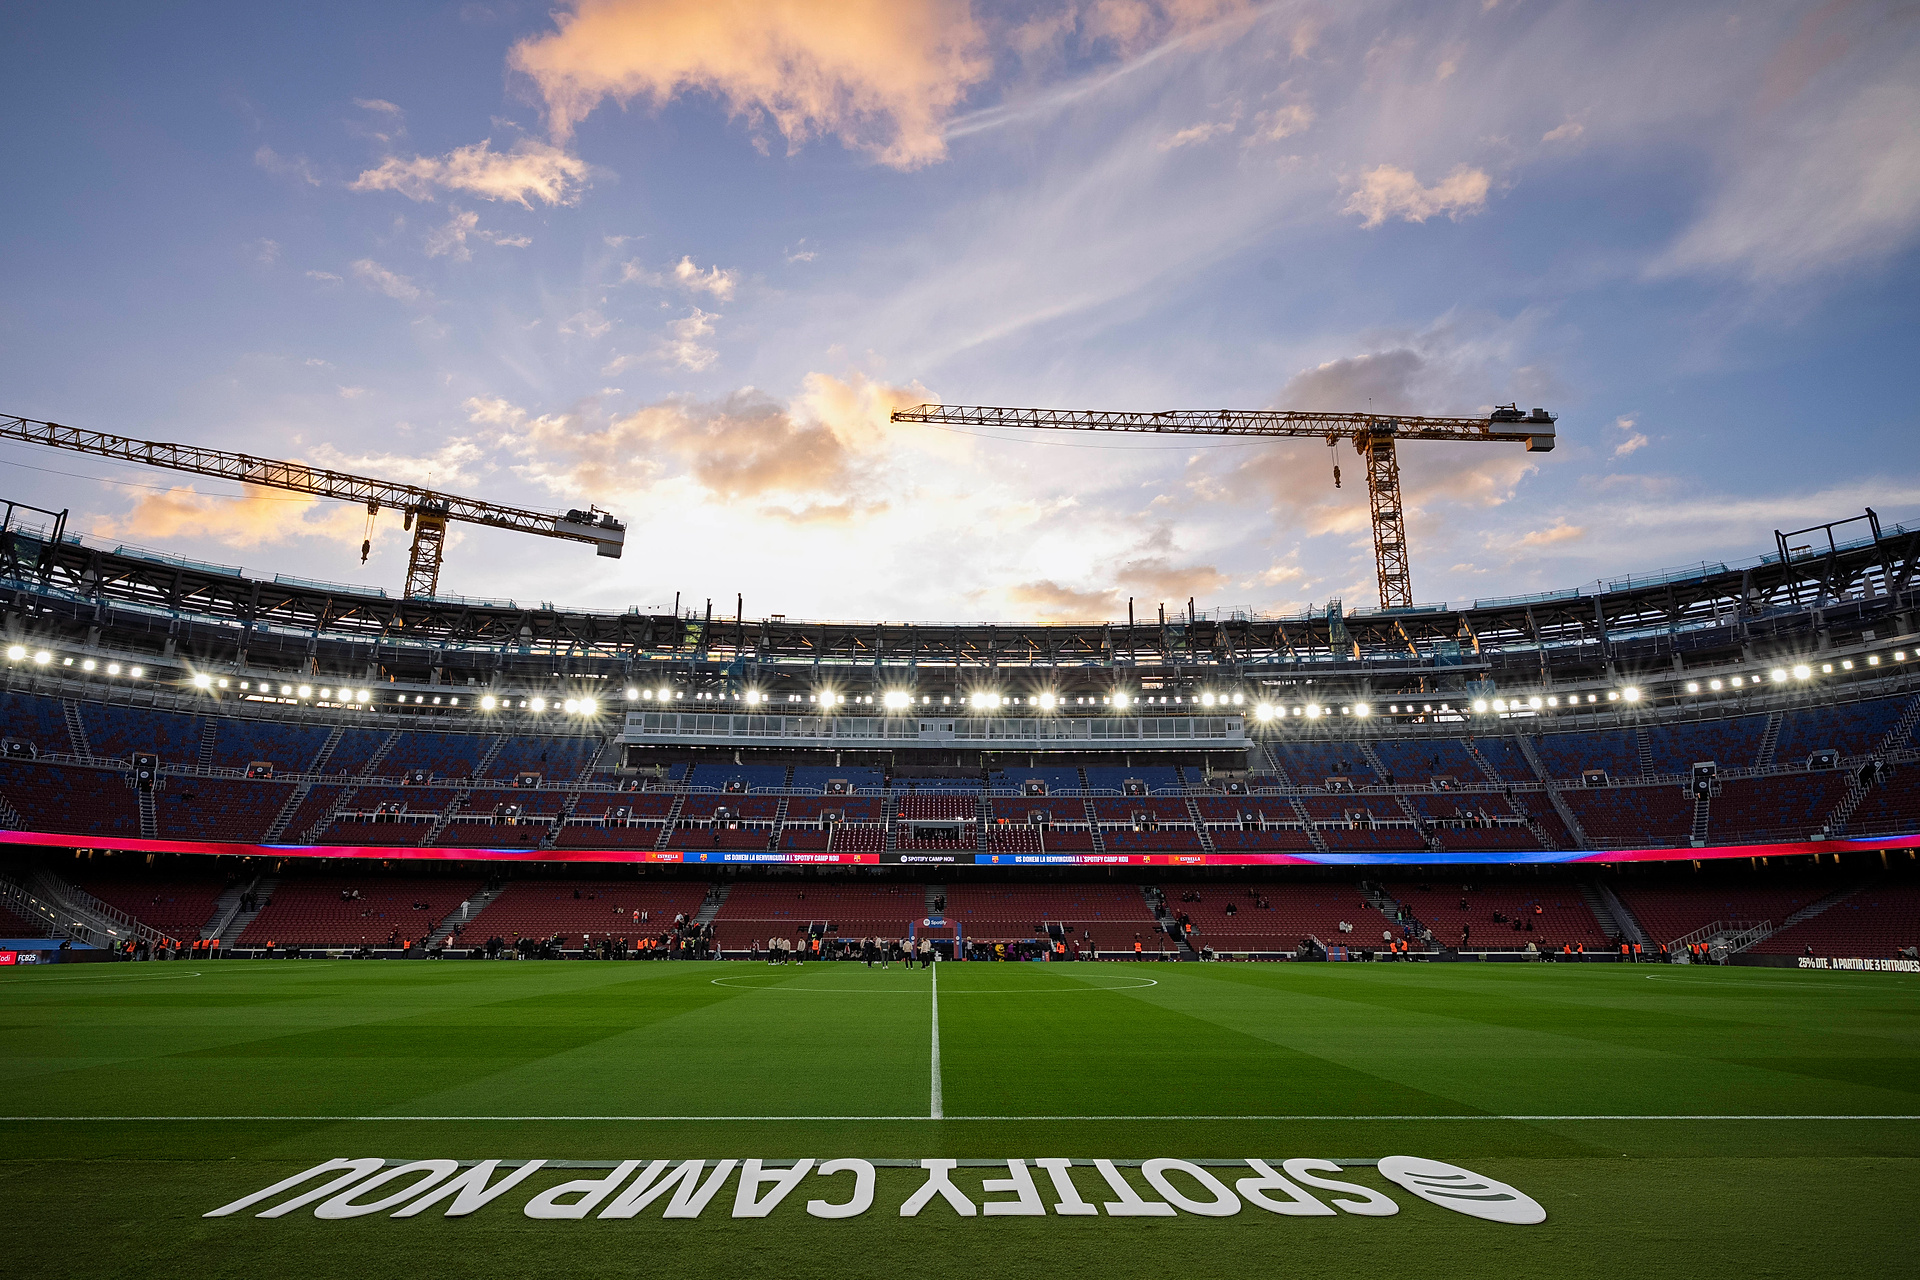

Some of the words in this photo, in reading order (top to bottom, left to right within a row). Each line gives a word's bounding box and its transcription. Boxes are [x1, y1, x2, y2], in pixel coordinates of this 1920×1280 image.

[1798, 957, 1815, 968] 25%
[1832, 958, 1838, 969] A
[1838, 958, 1864, 970] PARTIR
[1864, 959, 1874, 970] DE
[1875, 959, 1880, 971] 3
[1880, 959, 1920, 972] ENTRADES
[202, 1158, 548, 1219] NOU
[524, 1158, 876, 1219] CAMP
[900, 1158, 1399, 1216] SPOTIFY
